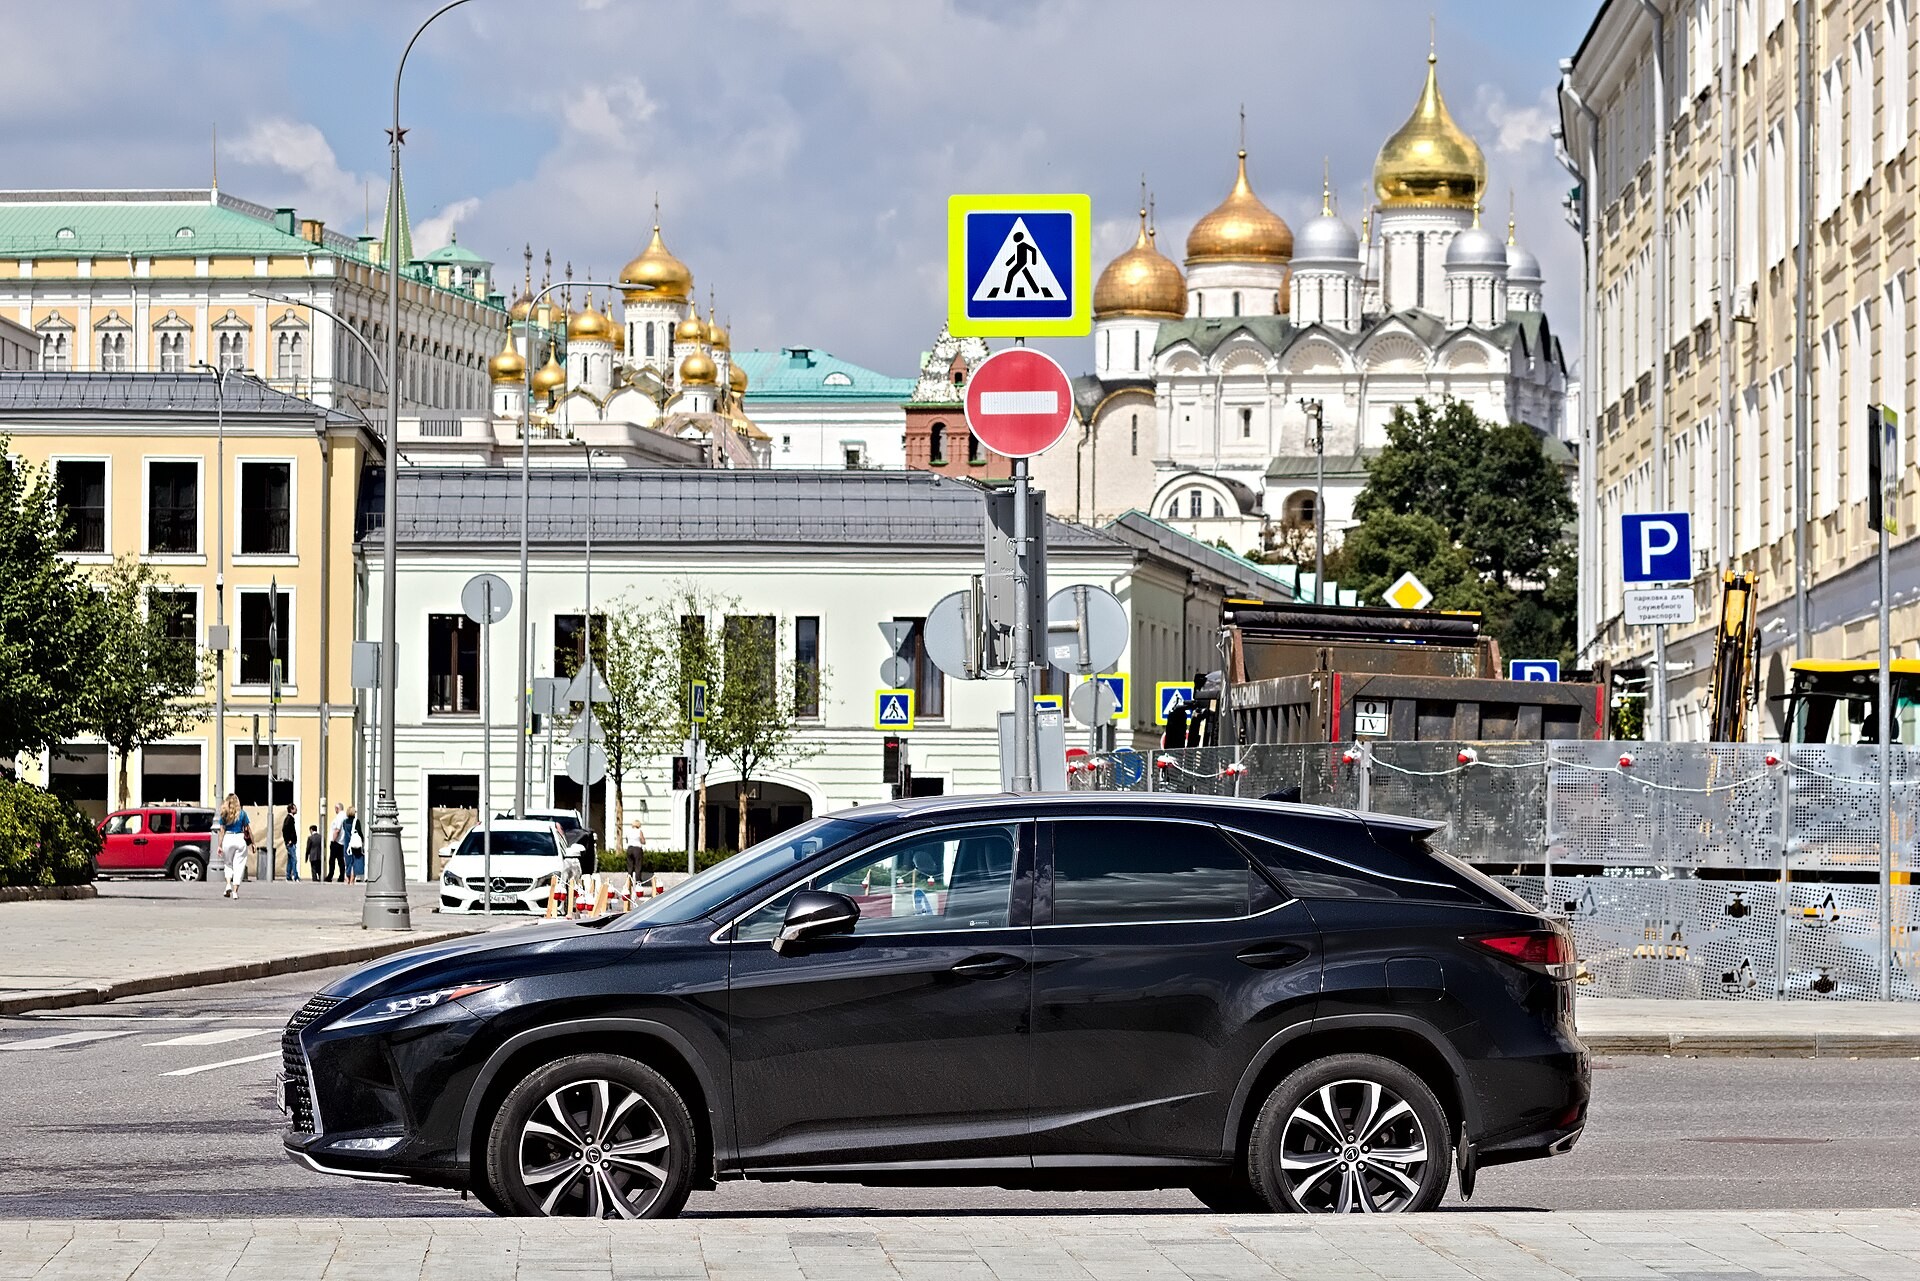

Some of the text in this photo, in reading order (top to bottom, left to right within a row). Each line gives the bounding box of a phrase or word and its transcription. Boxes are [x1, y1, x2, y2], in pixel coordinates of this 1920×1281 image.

[1640, 520, 1679, 575] P
[1637, 603, 1681, 611] служебного
[1361, 718, 1379, 731] IV
